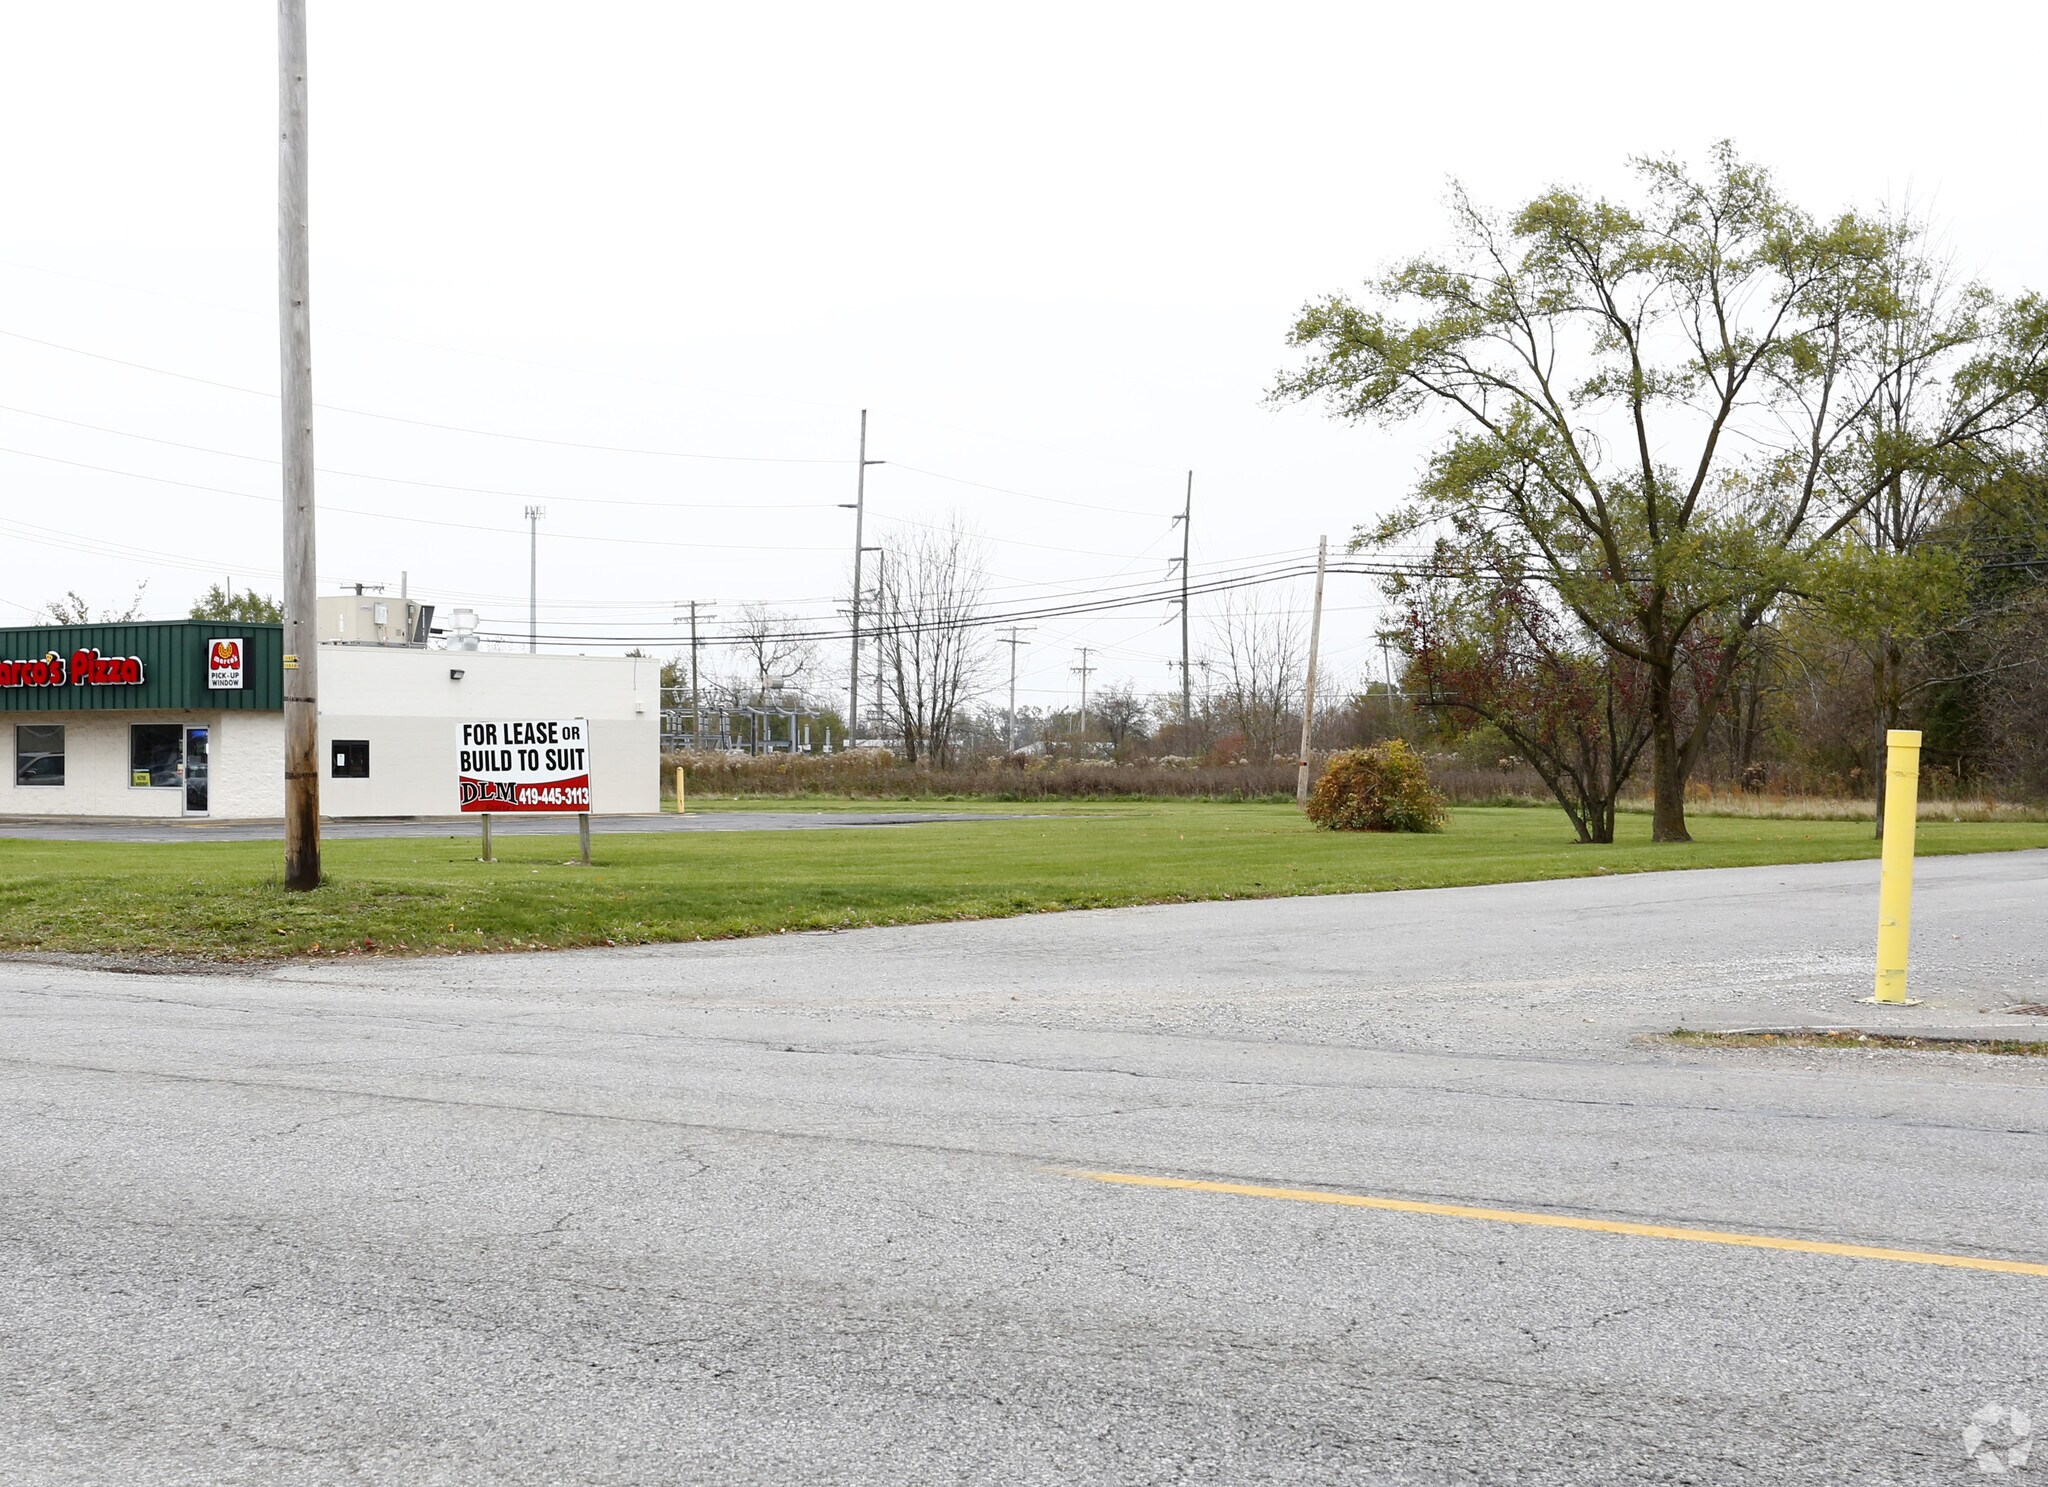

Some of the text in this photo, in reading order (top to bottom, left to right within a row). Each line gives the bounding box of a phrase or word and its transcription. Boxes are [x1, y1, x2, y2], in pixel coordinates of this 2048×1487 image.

[0, 649, 140, 686] arco's Pizza
[463, 722, 580, 746] FOR LEASE OR
[460, 748, 585, 772] BUILD TO SUIT
[460, 782, 589, 806] DLM 419-445-3113
